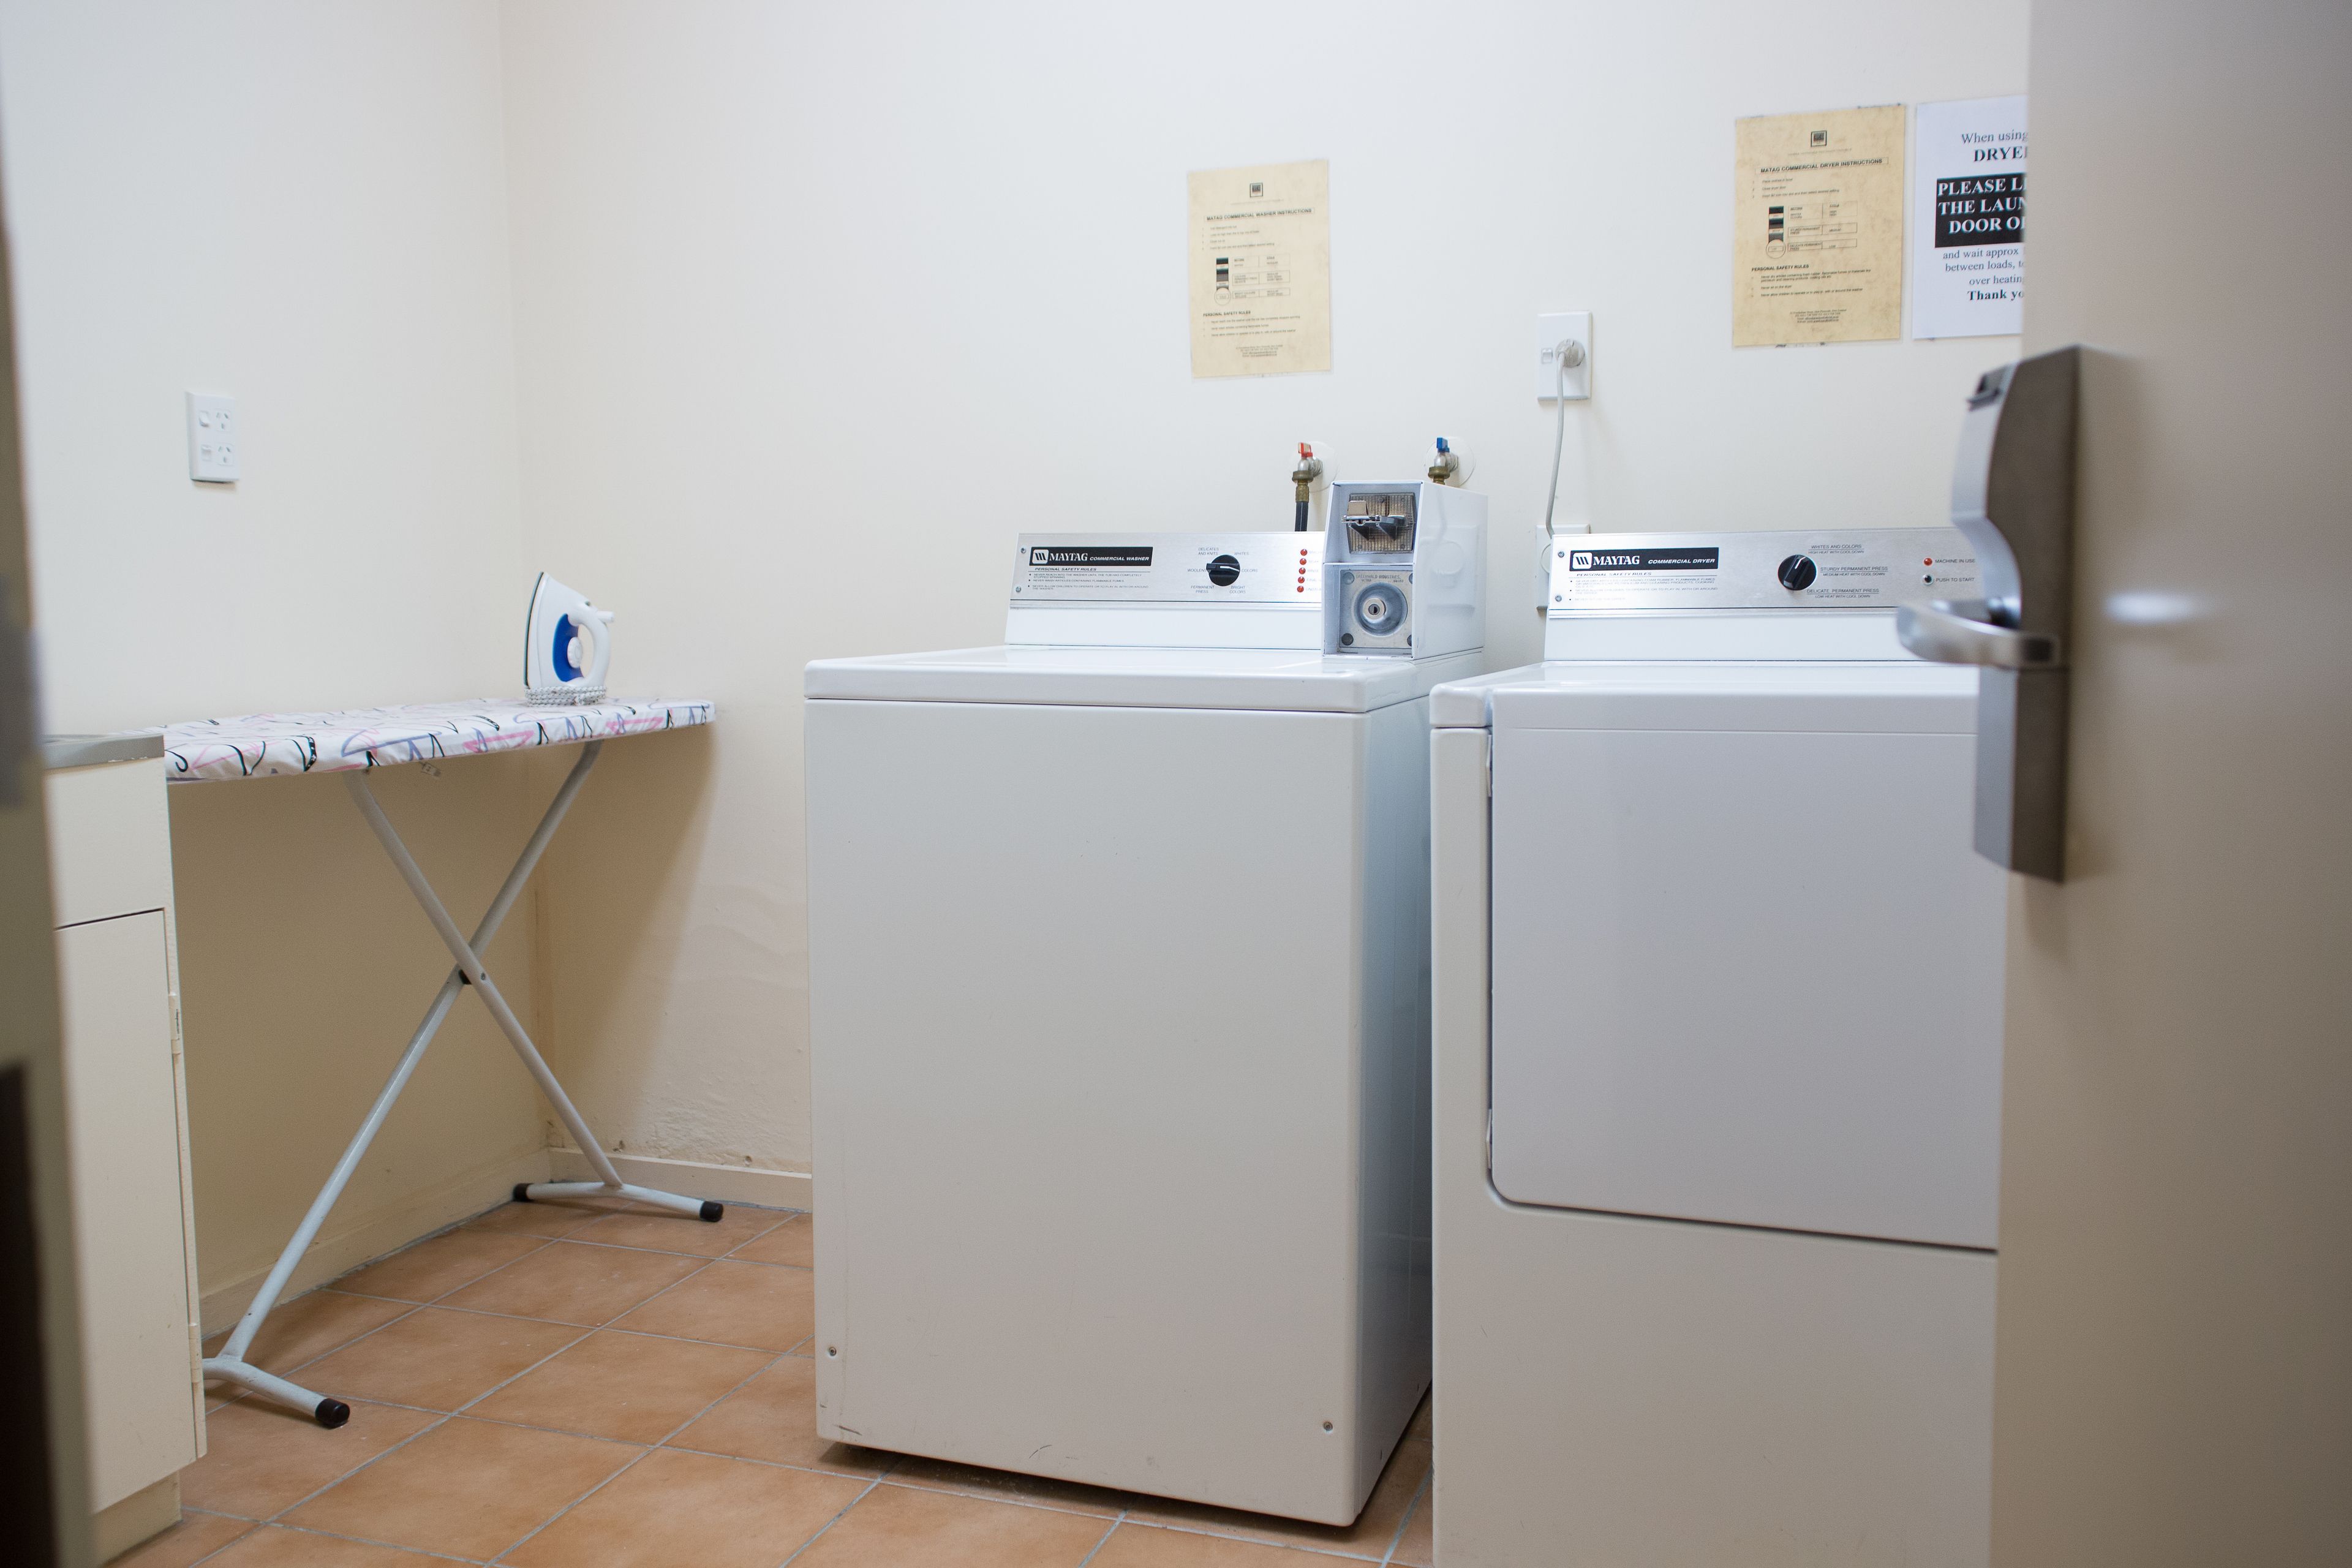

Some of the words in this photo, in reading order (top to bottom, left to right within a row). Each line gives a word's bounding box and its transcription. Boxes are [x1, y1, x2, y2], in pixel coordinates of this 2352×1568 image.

[1961, 132, 1994, 144] When
[1973, 146, 2027, 162] DRYE
[1937, 178, 2007, 197] PLEASE
[1939, 200, 1975, 216] THE
[1949, 217, 2002, 235] DOOR
[1943, 250, 1960, 259] and
[1963, 248, 1984, 258] wait
[1986, 248, 2019, 259] approx
[1945, 263, 1984, 272] between
[1988, 260, 2015, 270] loads,
[1993, 274, 2024, 284] heatin
[1967, 289, 2007, 301] Thank
[1049, 553, 1088, 562] MAYTAG
[1593, 556, 1640, 565] MAYTAG
